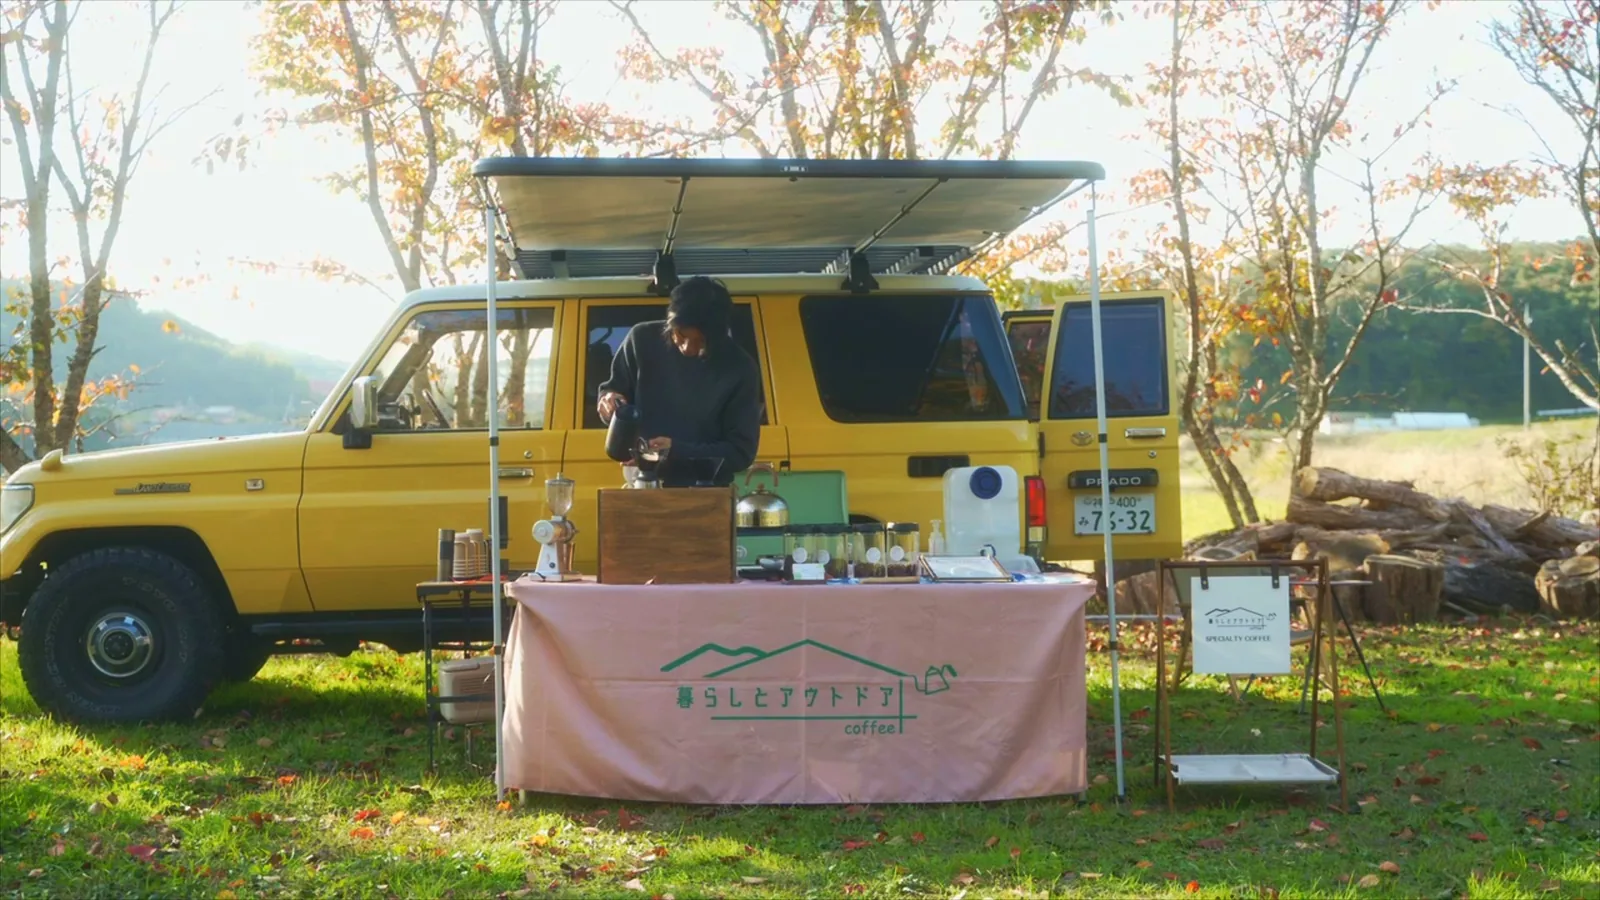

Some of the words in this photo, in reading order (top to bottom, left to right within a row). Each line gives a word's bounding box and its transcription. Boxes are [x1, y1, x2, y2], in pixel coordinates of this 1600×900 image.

[1116, 496, 1137, 508] 400
[676, 686, 893, 708] 暮らしとアウトドア
[844, 720, 896, 735] coffee
